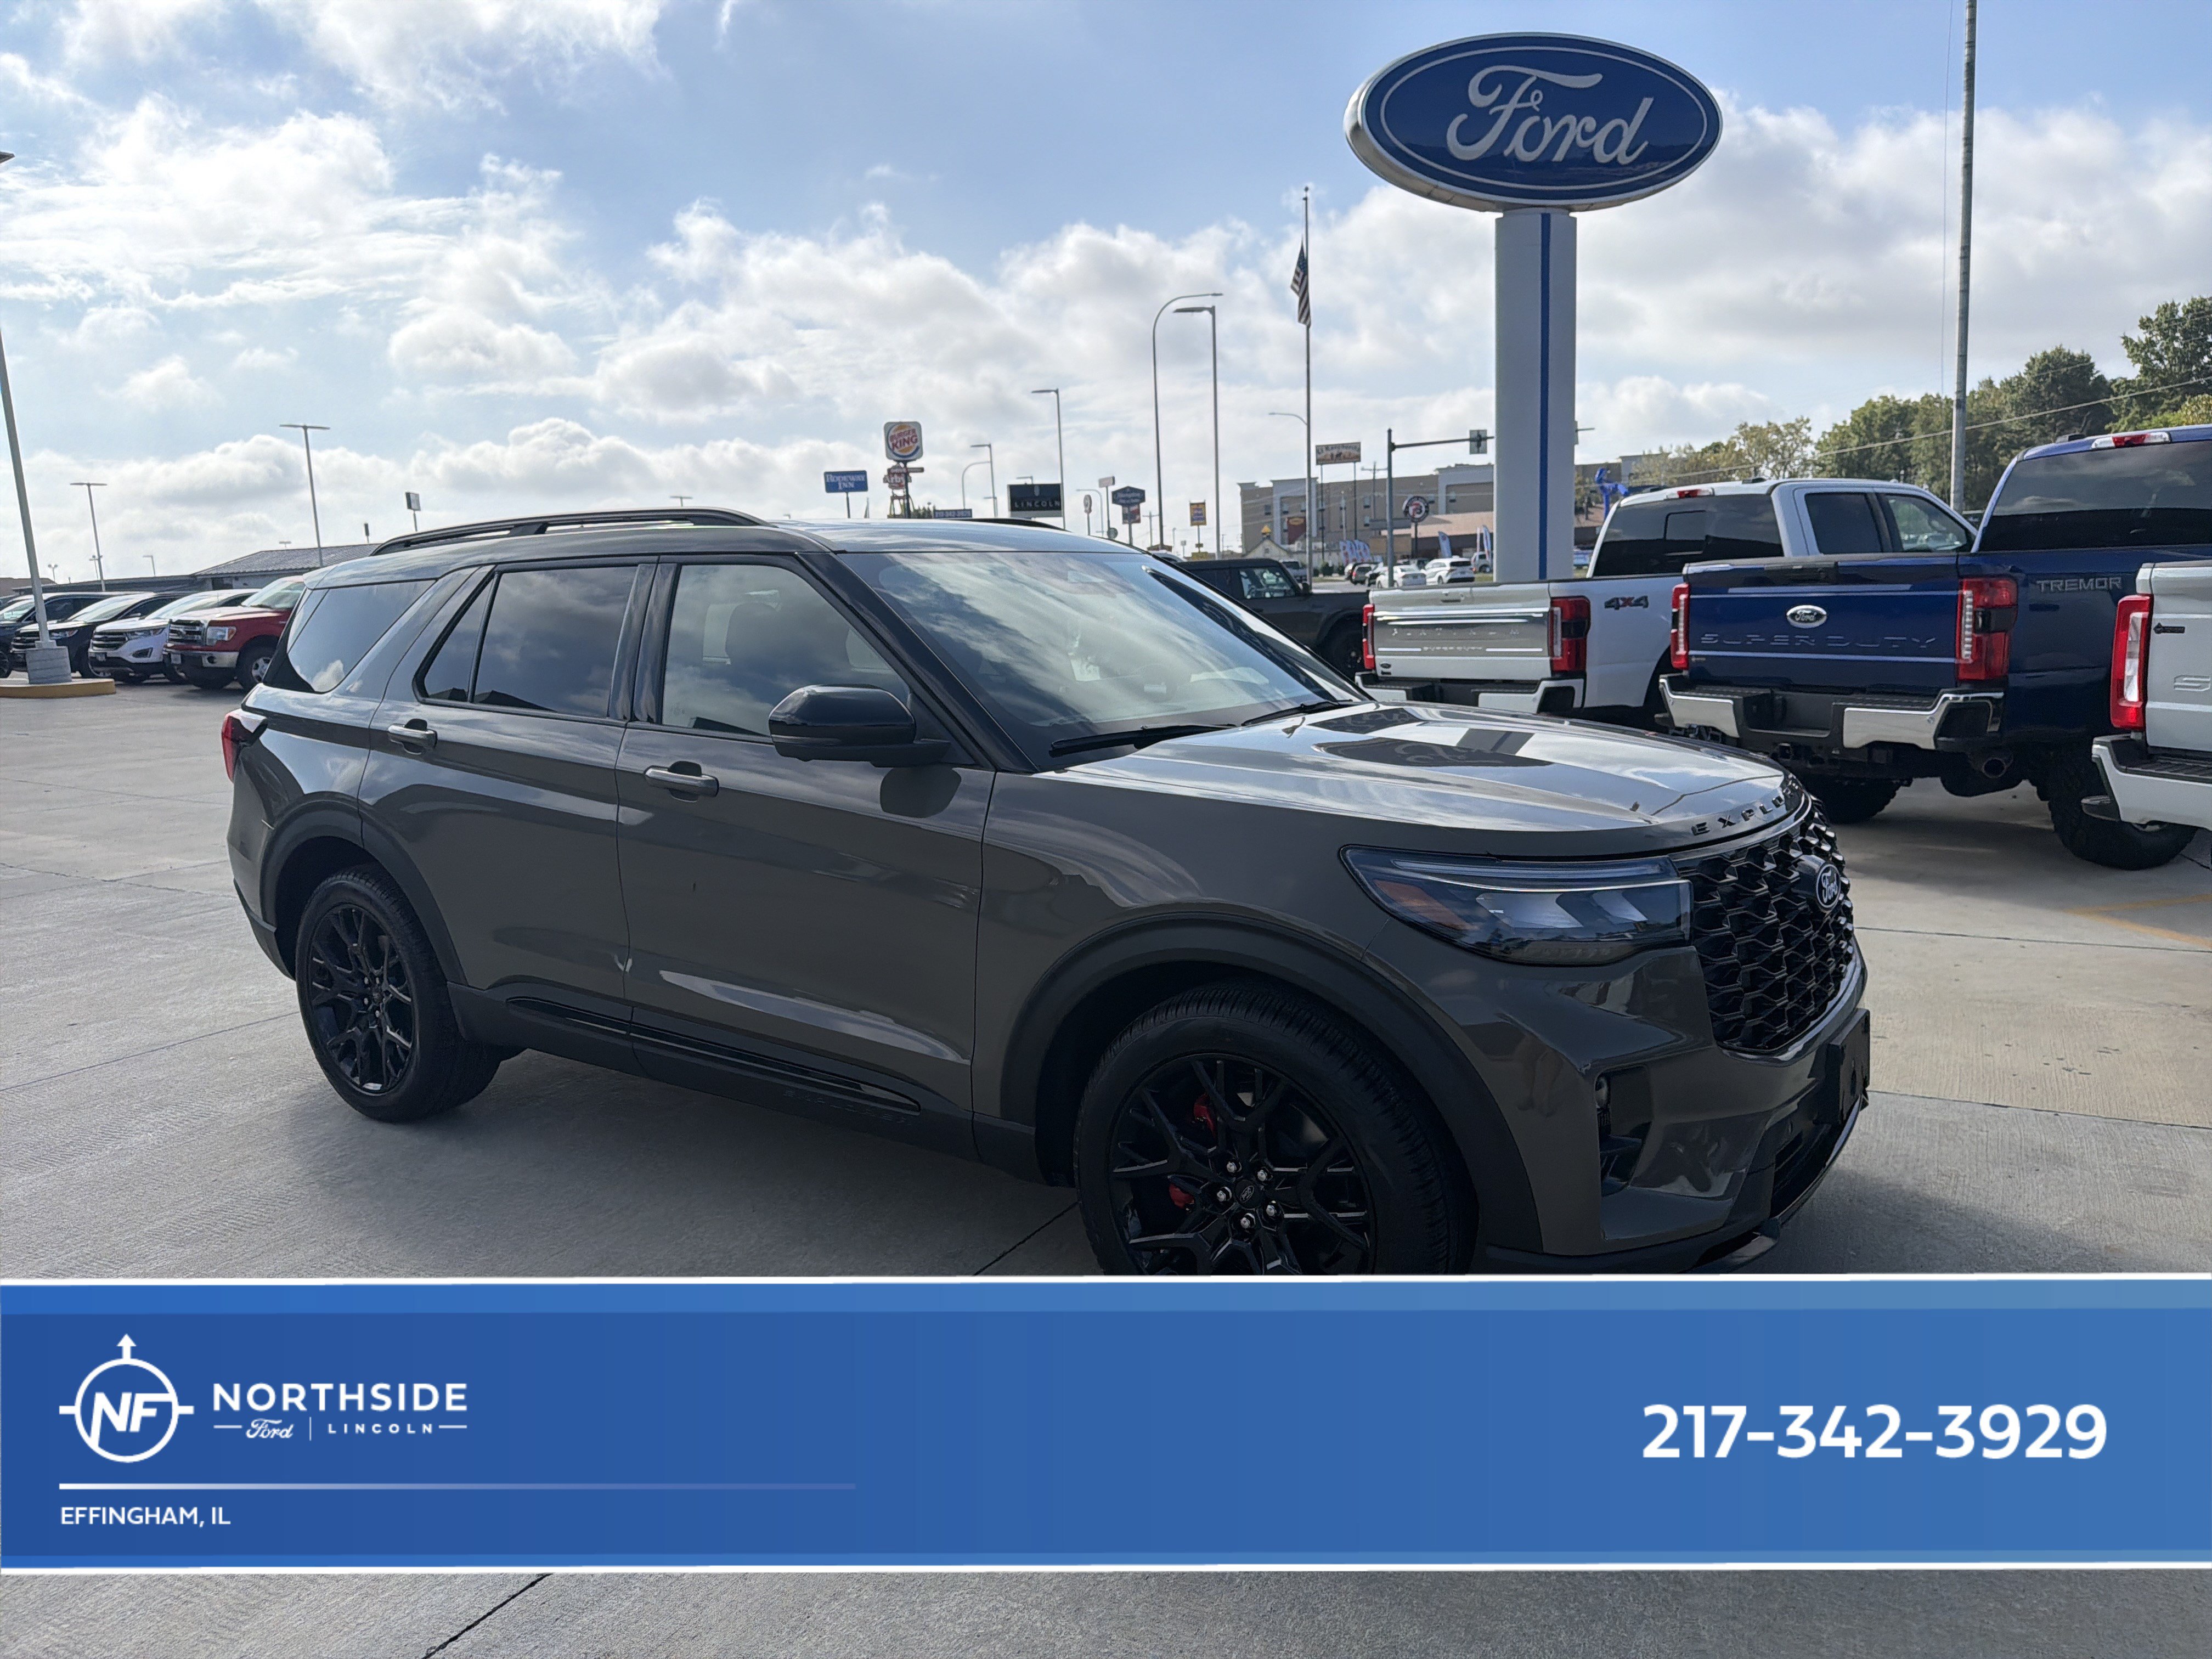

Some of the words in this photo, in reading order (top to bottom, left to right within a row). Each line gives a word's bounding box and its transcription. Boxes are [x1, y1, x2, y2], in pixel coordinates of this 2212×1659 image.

[1447, 65, 1654, 165] Ford
[889, 428, 916, 439] BURGER
[890, 435, 918, 451] KING
[826, 474, 866, 482] RODEWAY
[838, 482, 855, 490] INN
[2036, 577, 2123, 592] TREMOR
[1795, 610, 1818, 623] Ford
[1701, 633, 1815, 646] SUPER
[1826, 635, 1936, 648] DUTY
[1822, 869, 1838, 904] Ford
